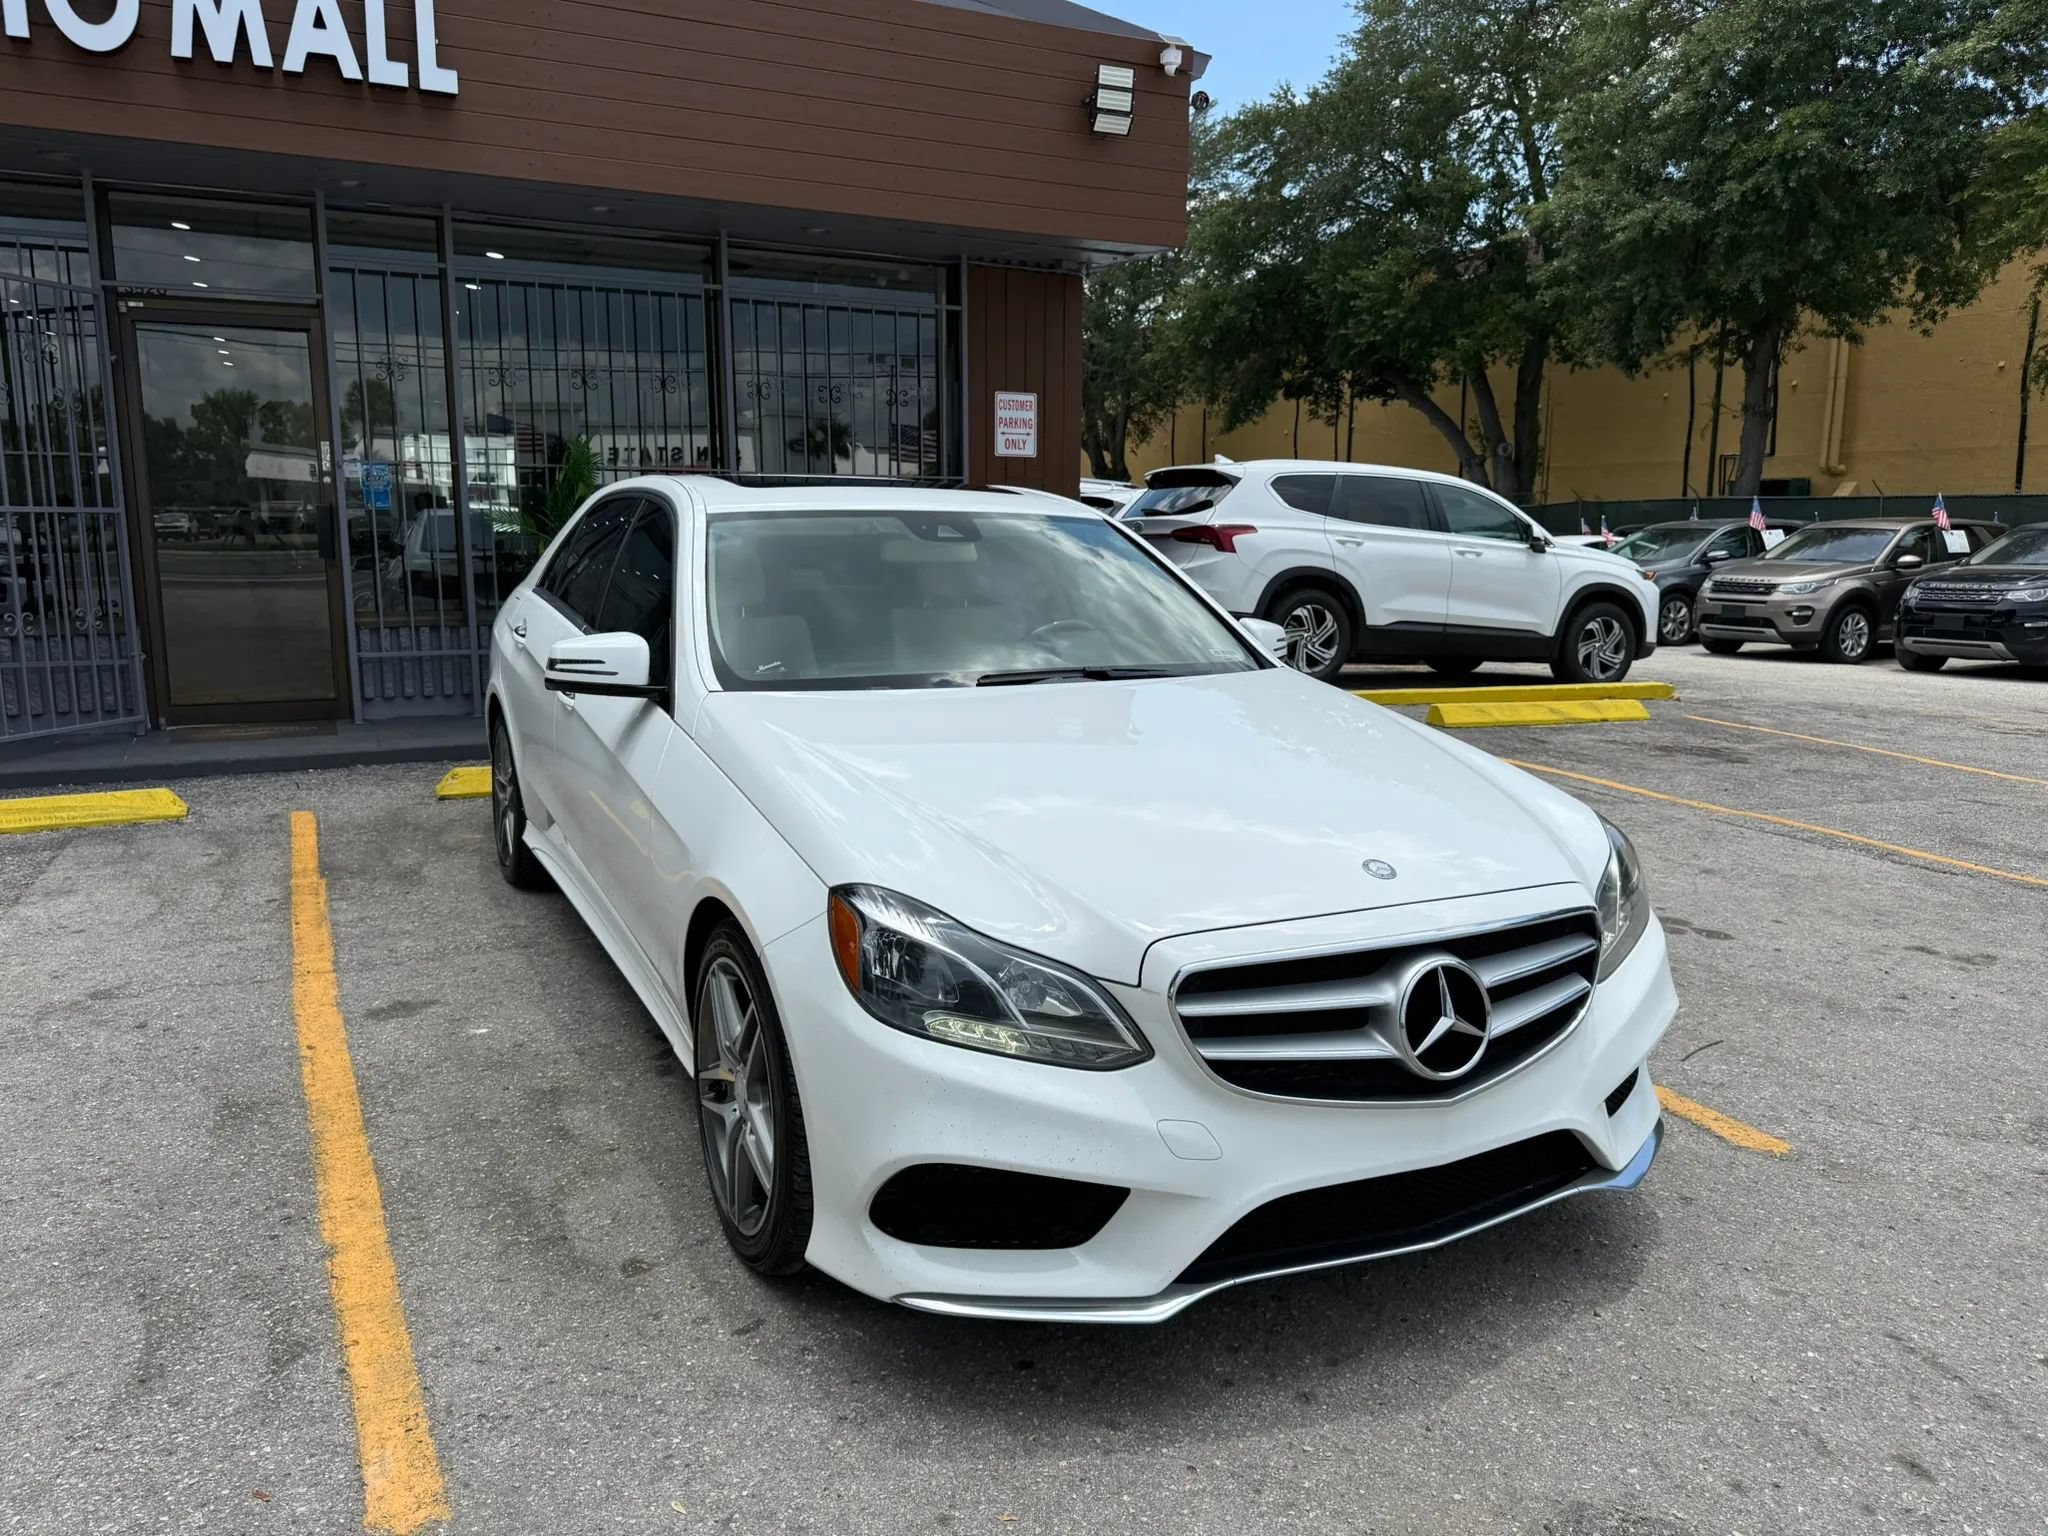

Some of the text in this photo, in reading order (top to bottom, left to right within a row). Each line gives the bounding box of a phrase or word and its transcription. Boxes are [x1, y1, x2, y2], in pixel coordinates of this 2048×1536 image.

[170, 0, 459, 94] MALL
[998, 398, 1033, 412] CUSTOMER
[998, 416, 1033, 430] PARKING
[1004, 438, 1027, 451] ONLY
